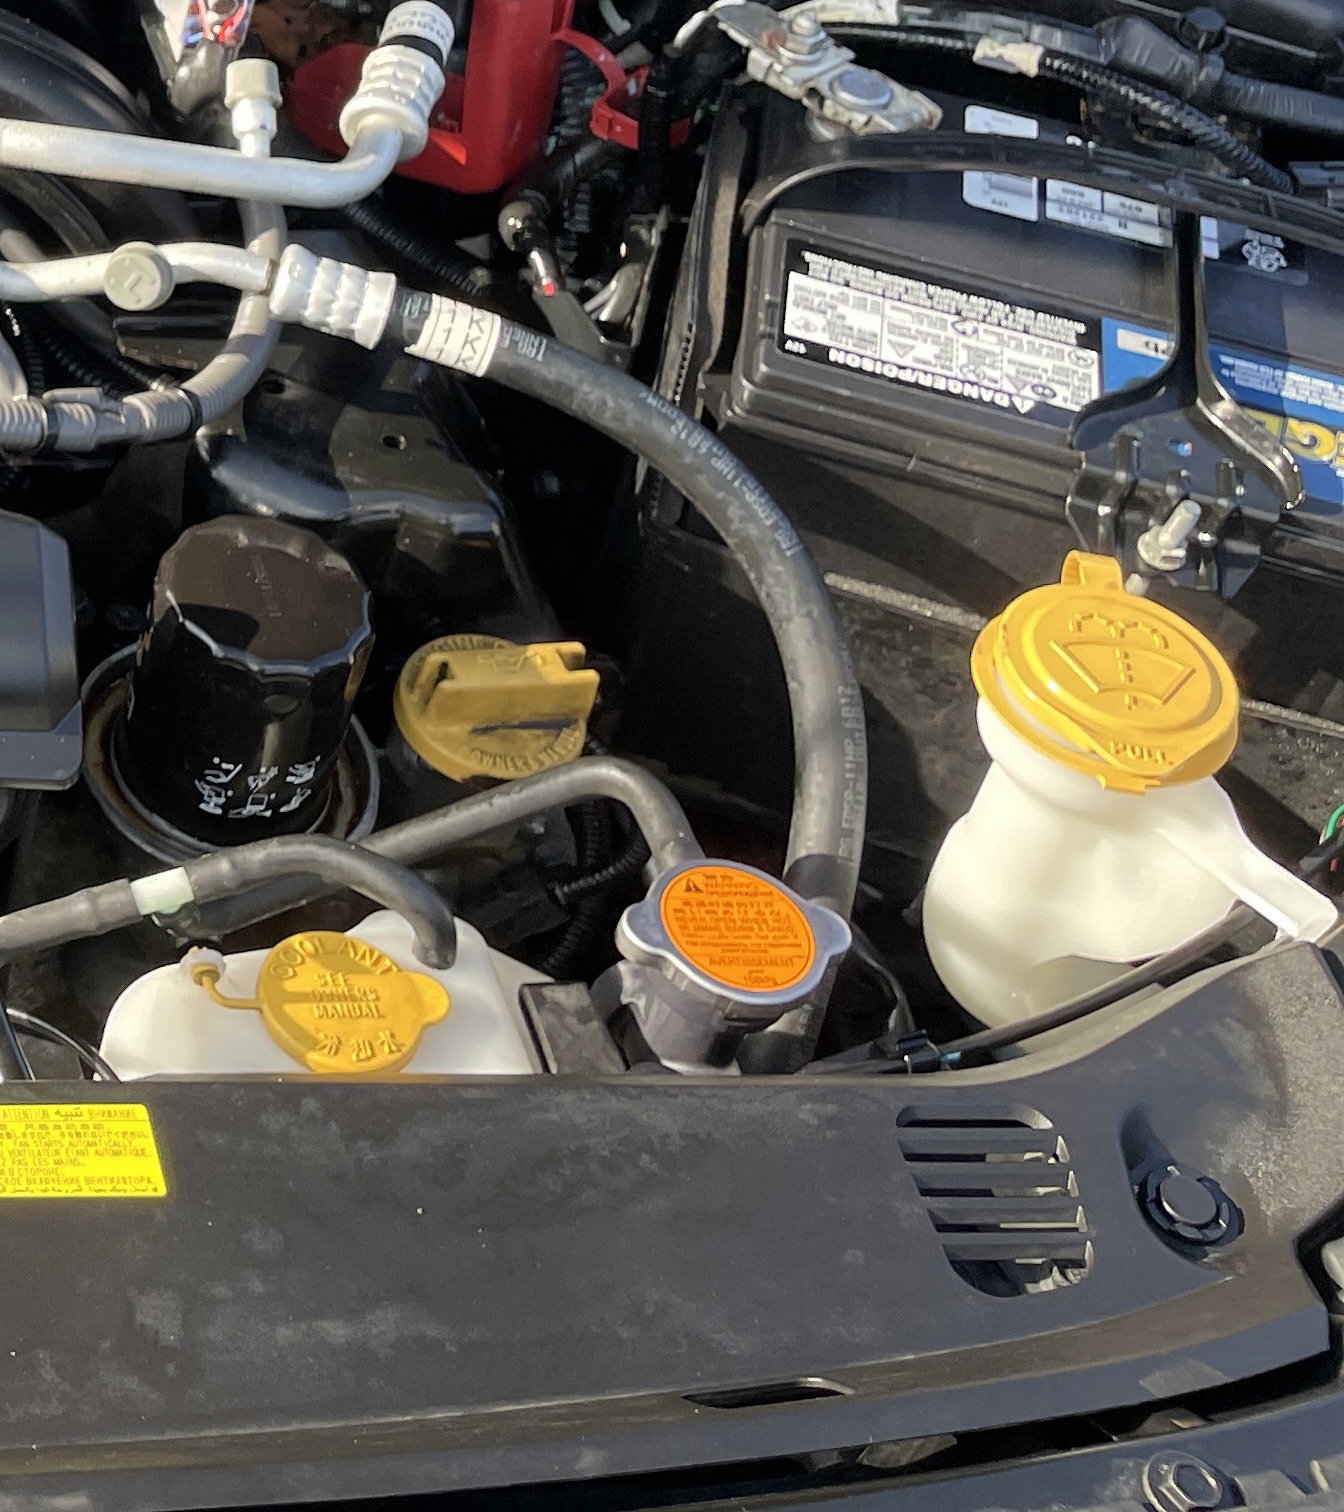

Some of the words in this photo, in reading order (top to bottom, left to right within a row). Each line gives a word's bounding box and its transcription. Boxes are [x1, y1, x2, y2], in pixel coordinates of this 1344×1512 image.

[828, 347, 1010, 408] DANGER/POISON
[269, 934, 402, 981] COOLANT
[312, 1002, 387, 1019] MANUAL
[315, 1030, 407, 1063] 冷却水
[2, 1108, 50, 1121] ATTENTION
[87, 1108, 138, 1120] ВНИМАНИЕ
[13, 1140, 30, 1148] FAN
[33, 1139, 65, 1148] STARTS
[8, 1148, 61, 1158] VENTILATEUR
[12, 1157, 29, 1167] PAS
[33, 1157, 50, 1167] LES
[25, 1176, 81, 1186] ВКЛЮЧЕНИЕ
